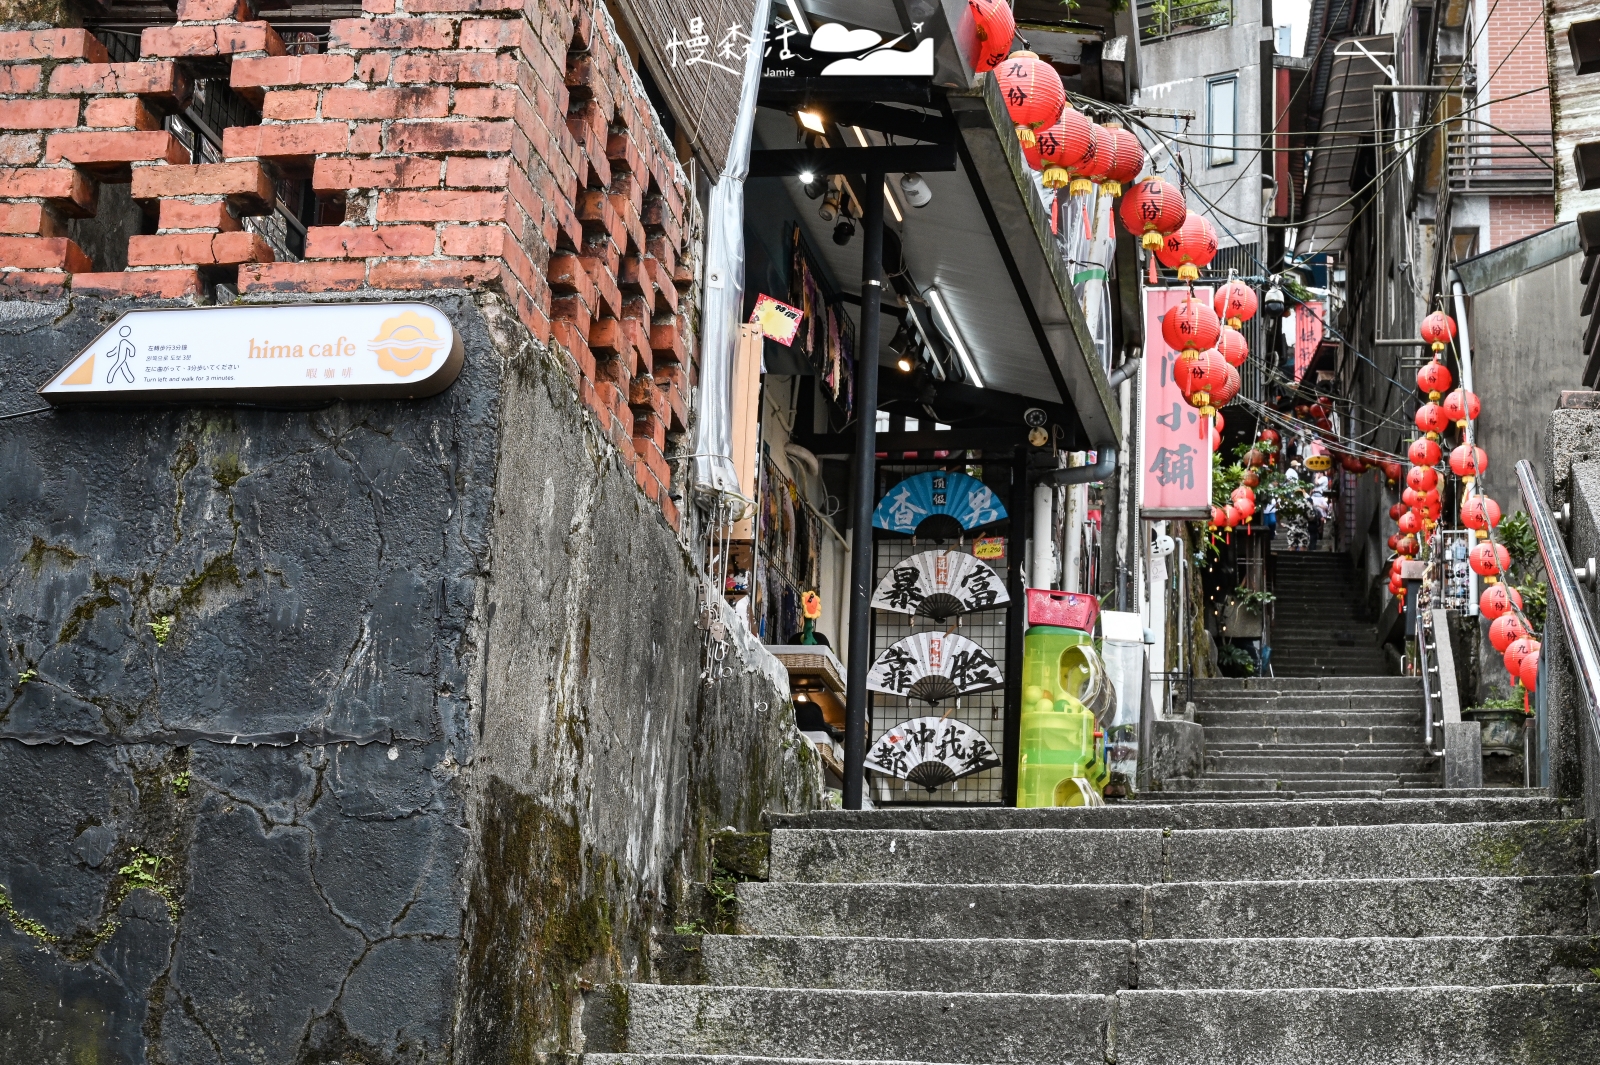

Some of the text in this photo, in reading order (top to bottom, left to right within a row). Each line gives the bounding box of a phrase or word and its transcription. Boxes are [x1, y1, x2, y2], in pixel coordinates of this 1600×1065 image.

[1007, 62, 1028, 106] 九份
[1141, 181, 1161, 220] 九份
[1232, 287, 1243, 310] 九份
[775, 305, 798, 319] 特價
[1432, 315, 1443, 336] 九份
[248, 336, 356, 359] hima cafe
[1428, 367, 1437, 384] 九份
[1483, 549, 1493, 570] 九份
[1494, 589, 1505, 612] 九份
[1506, 618, 1517, 641] 九份
